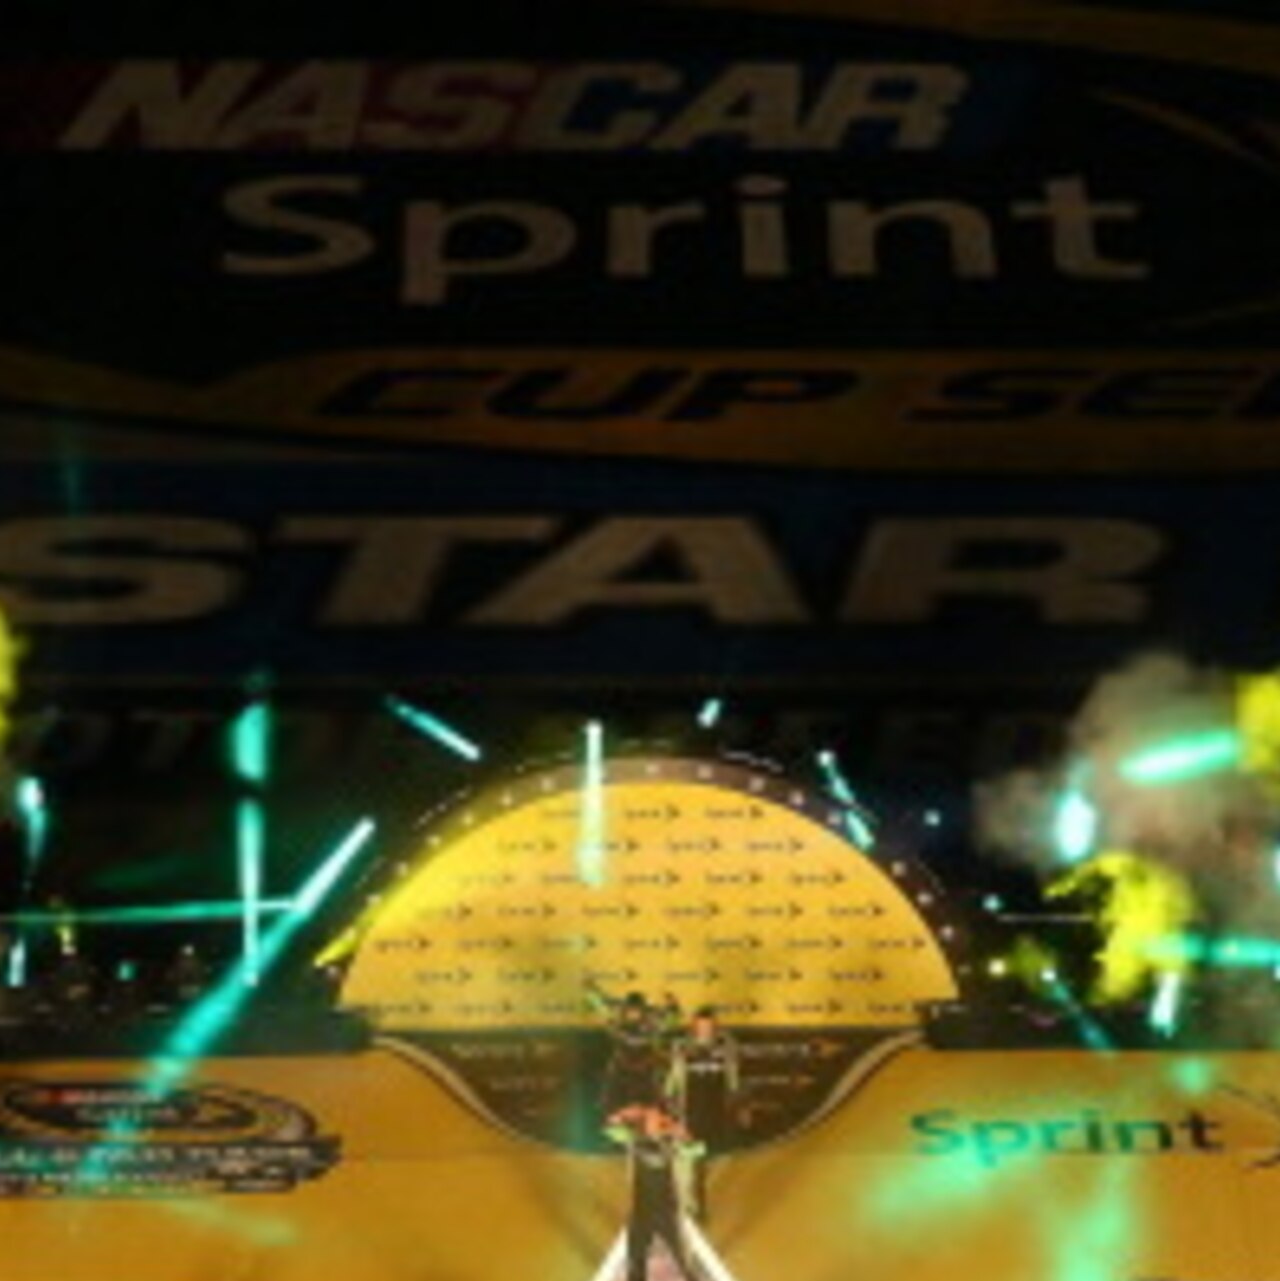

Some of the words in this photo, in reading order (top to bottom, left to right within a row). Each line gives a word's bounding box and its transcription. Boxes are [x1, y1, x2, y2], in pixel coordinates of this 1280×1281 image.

[54, 58, 972, 152] NASCAR
[215, 171, 1154, 307] Sprint
[320, 369, 861, 420] CUP
[908, 1108, 1226, 1166] Sprint
